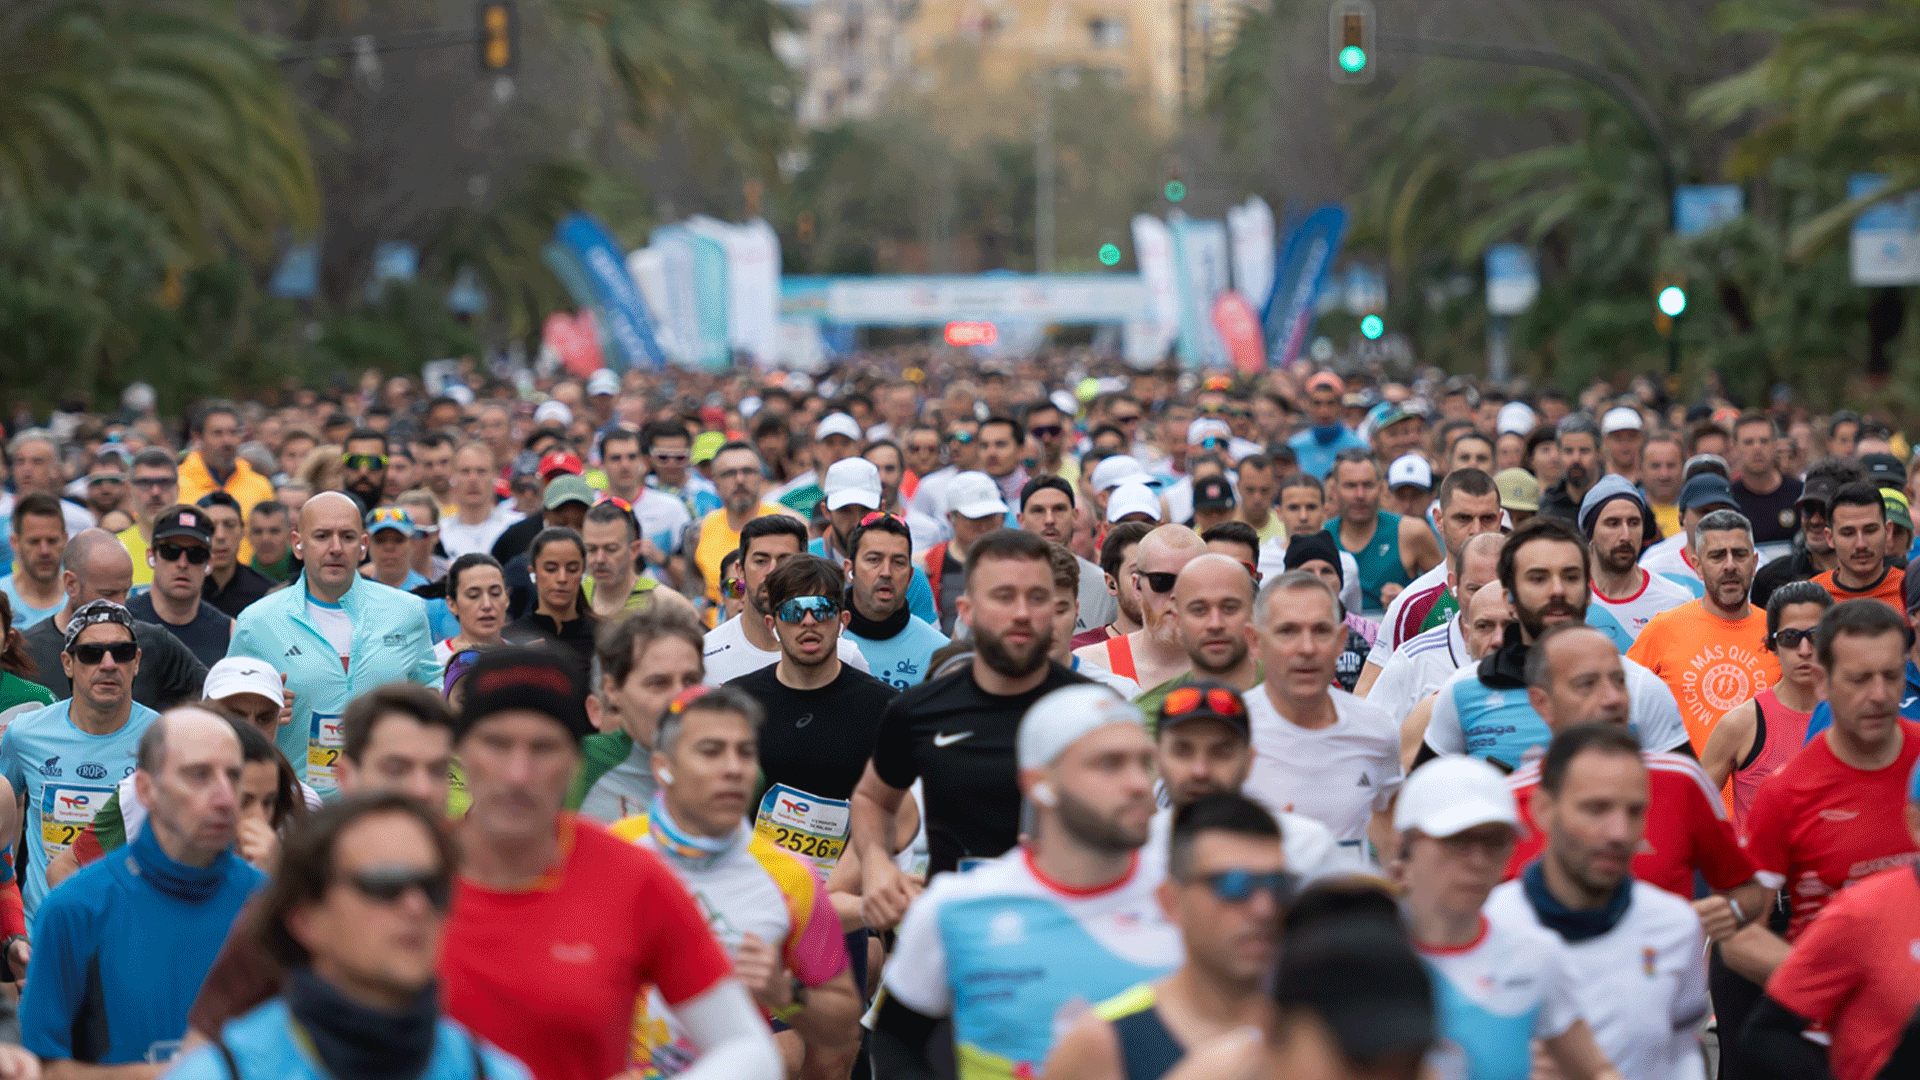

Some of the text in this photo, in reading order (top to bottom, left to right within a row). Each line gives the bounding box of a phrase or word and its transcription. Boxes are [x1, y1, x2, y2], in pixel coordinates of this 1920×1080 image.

[1690, 645, 1725, 671] MÁS
[1728, 645, 1759, 671] QUE
[1682, 670, 1714, 726] MUCHO
[77, 764, 108, 779] TROPS
[774, 827, 831, 858] 2526
